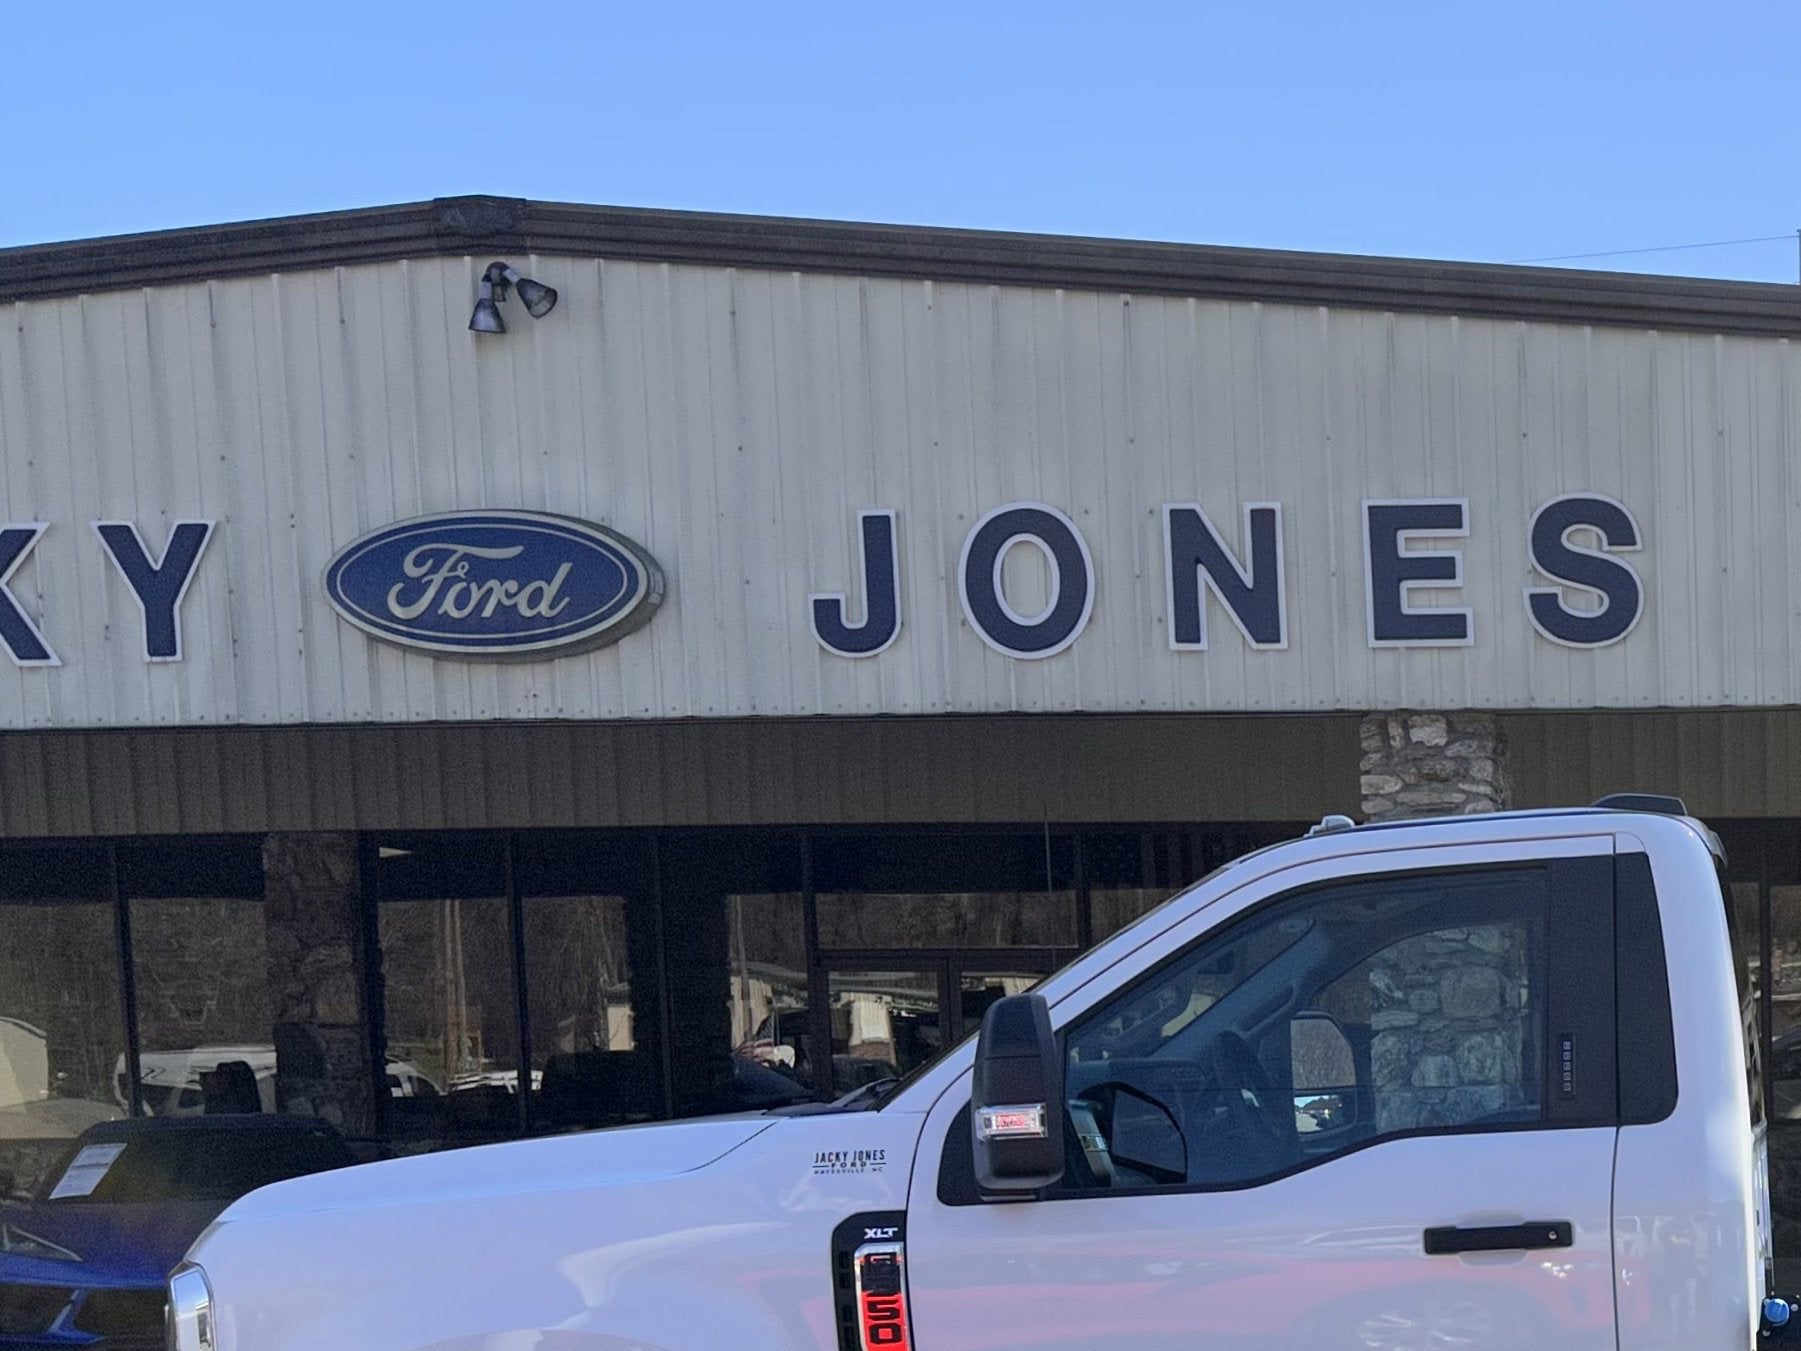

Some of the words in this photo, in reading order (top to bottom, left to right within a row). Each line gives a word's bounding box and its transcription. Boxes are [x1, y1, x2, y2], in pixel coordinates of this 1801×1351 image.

[387, 542, 573, 619] Ford
[808, 491, 1645, 660] JONES
[814, 1151, 848, 1163] JACKY
[853, 1149, 886, 1162] JONES
[864, 1227, 899, 1239] XLT
